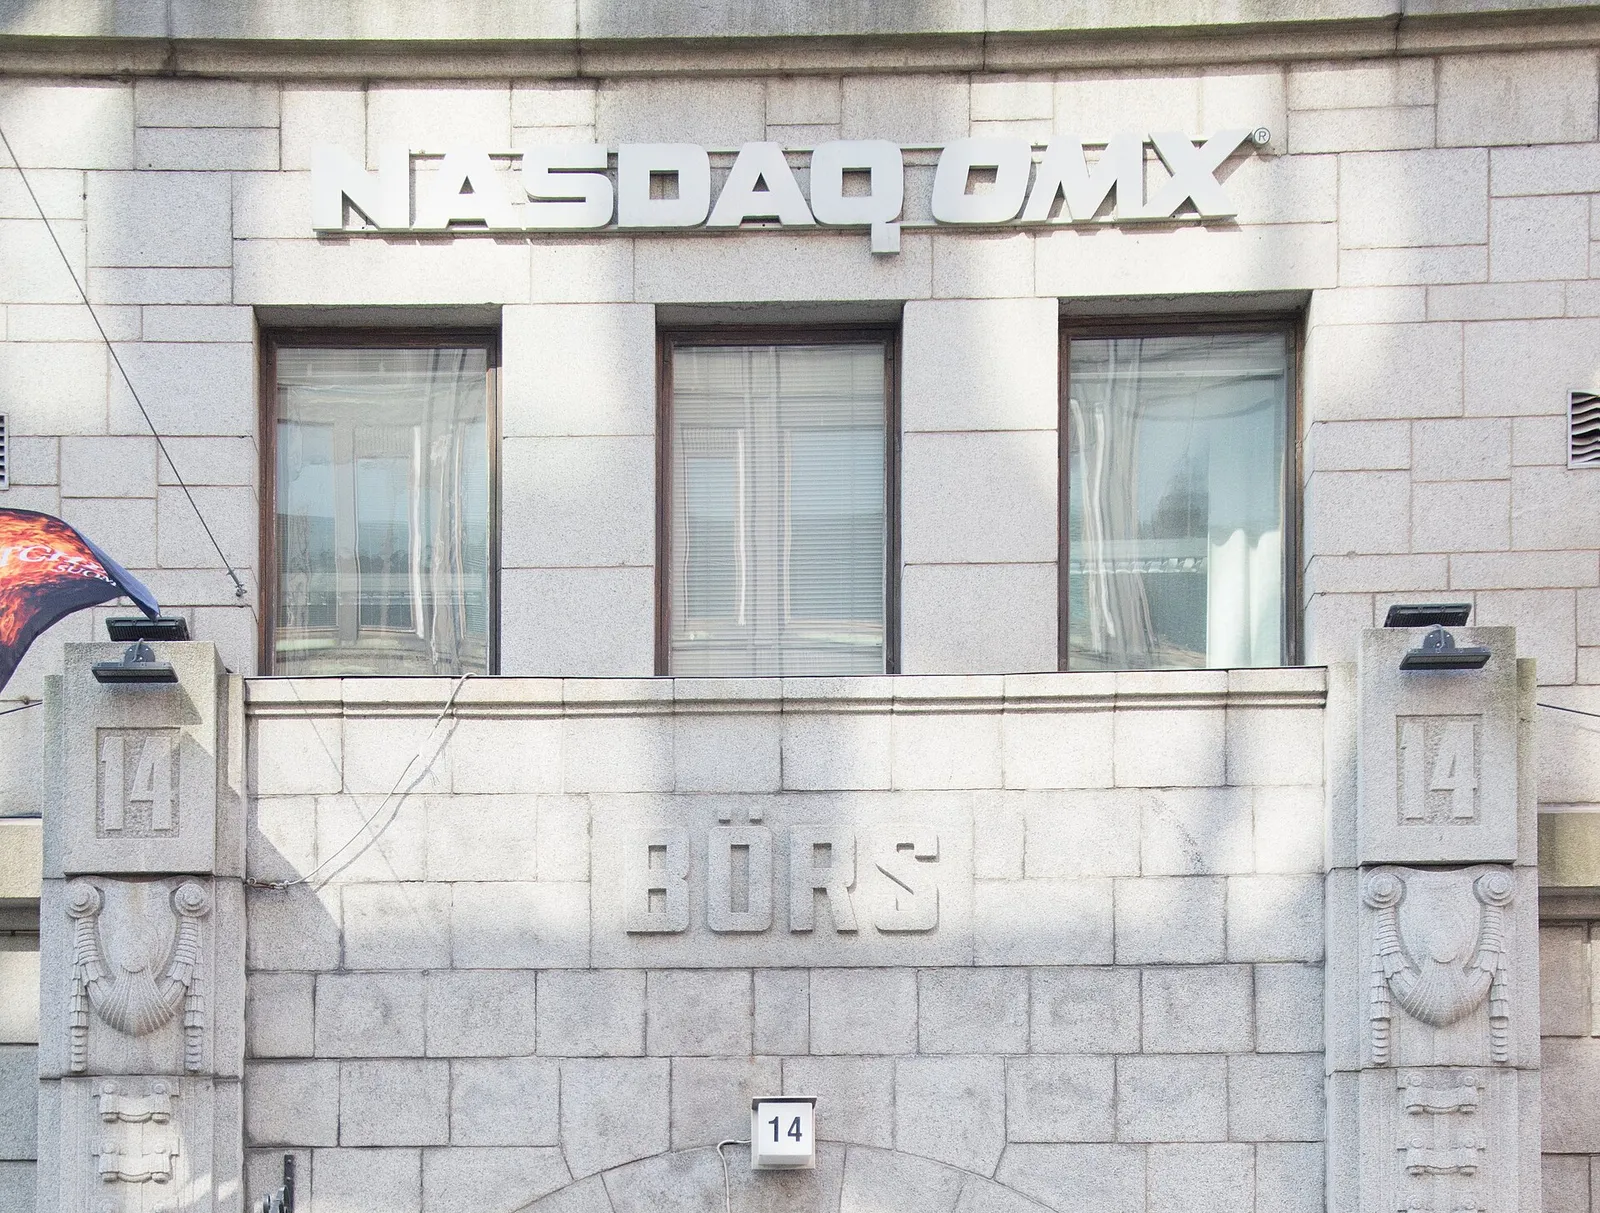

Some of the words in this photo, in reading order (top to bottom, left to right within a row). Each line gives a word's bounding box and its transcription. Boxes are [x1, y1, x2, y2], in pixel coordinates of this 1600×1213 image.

[310, 139, 904, 255] NASDAQ
[101, 736, 172, 831] 14
[1400, 720, 1476, 820] 14
[624, 808, 940, 934] BÖRS
[767, 1116, 803, 1143] 14
